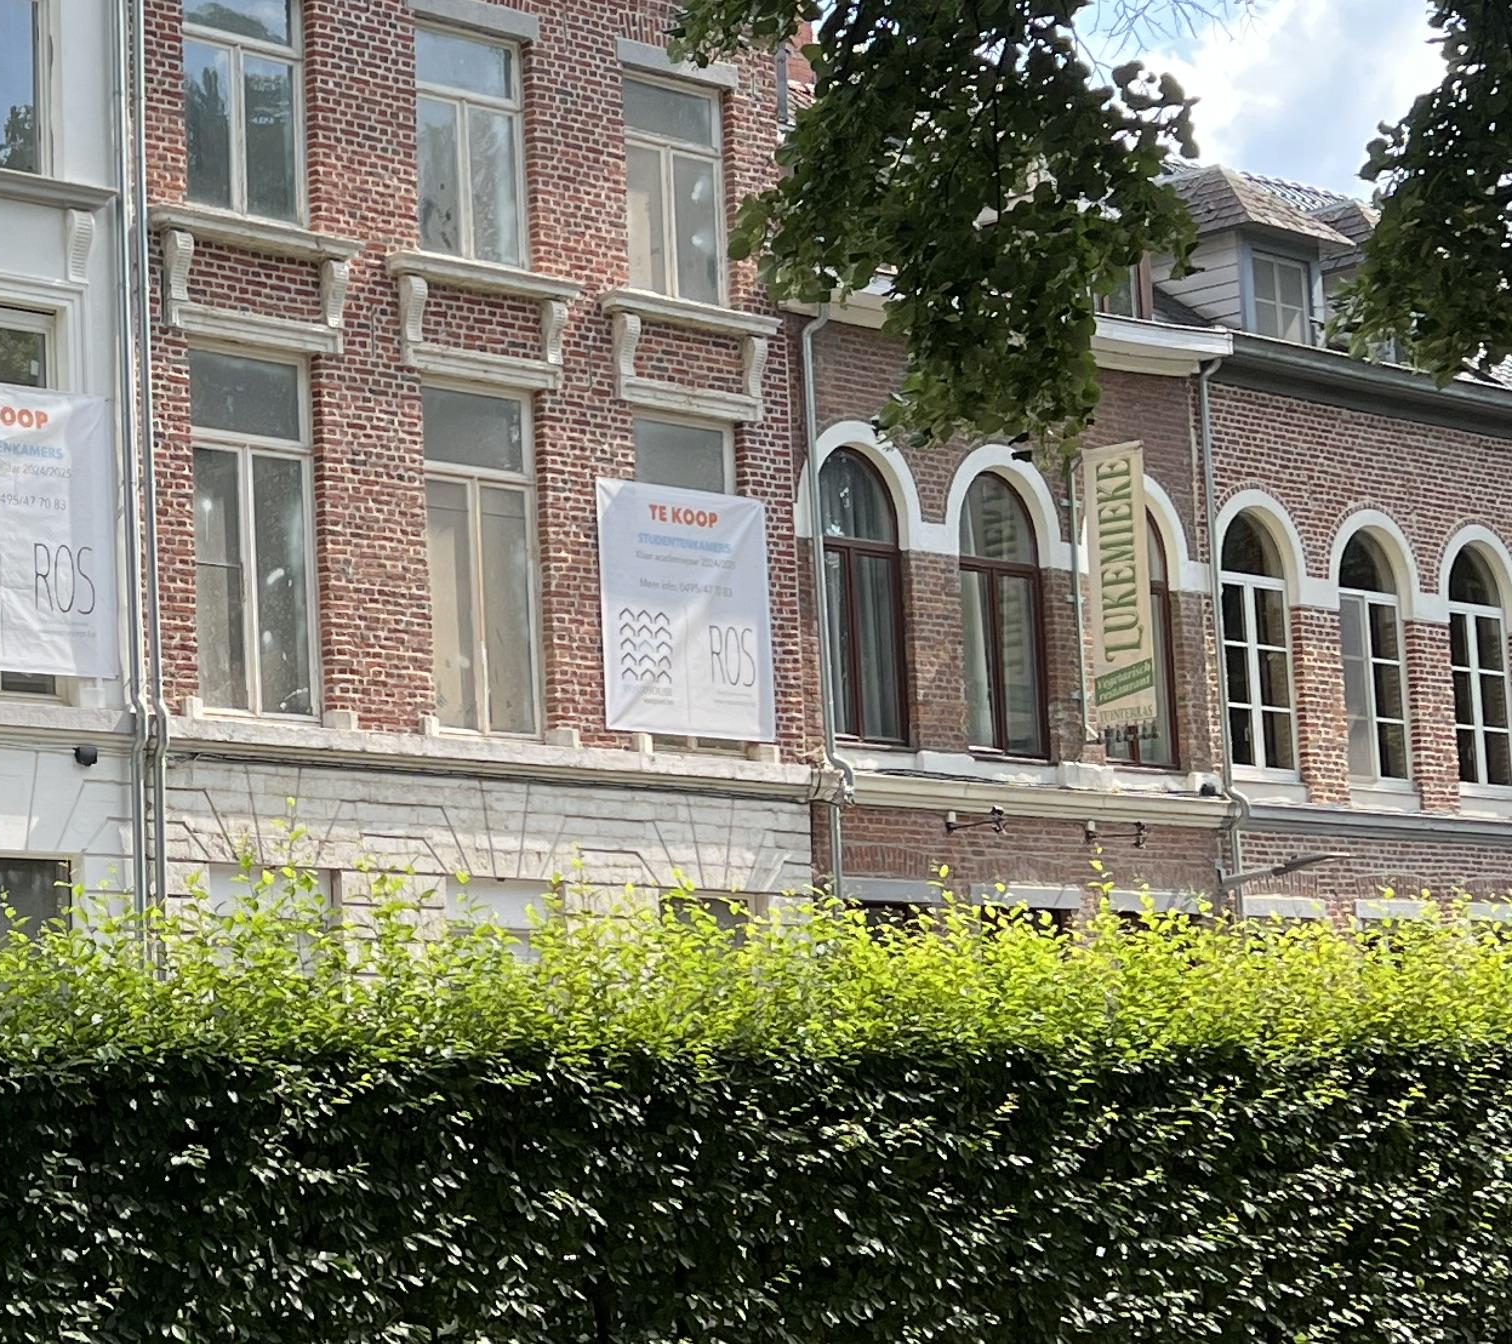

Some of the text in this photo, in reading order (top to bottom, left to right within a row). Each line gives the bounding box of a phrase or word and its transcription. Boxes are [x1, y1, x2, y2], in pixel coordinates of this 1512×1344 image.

[38, 495, 51, 508] 70
[648, 503, 719, 529] TE KOOP
[33, 542, 96, 615] ROS
[1096, 458, 1143, 662] LUKEMIEKE
[709, 624, 757, 688] ROS
[1099, 674, 1151, 701] restaurant
